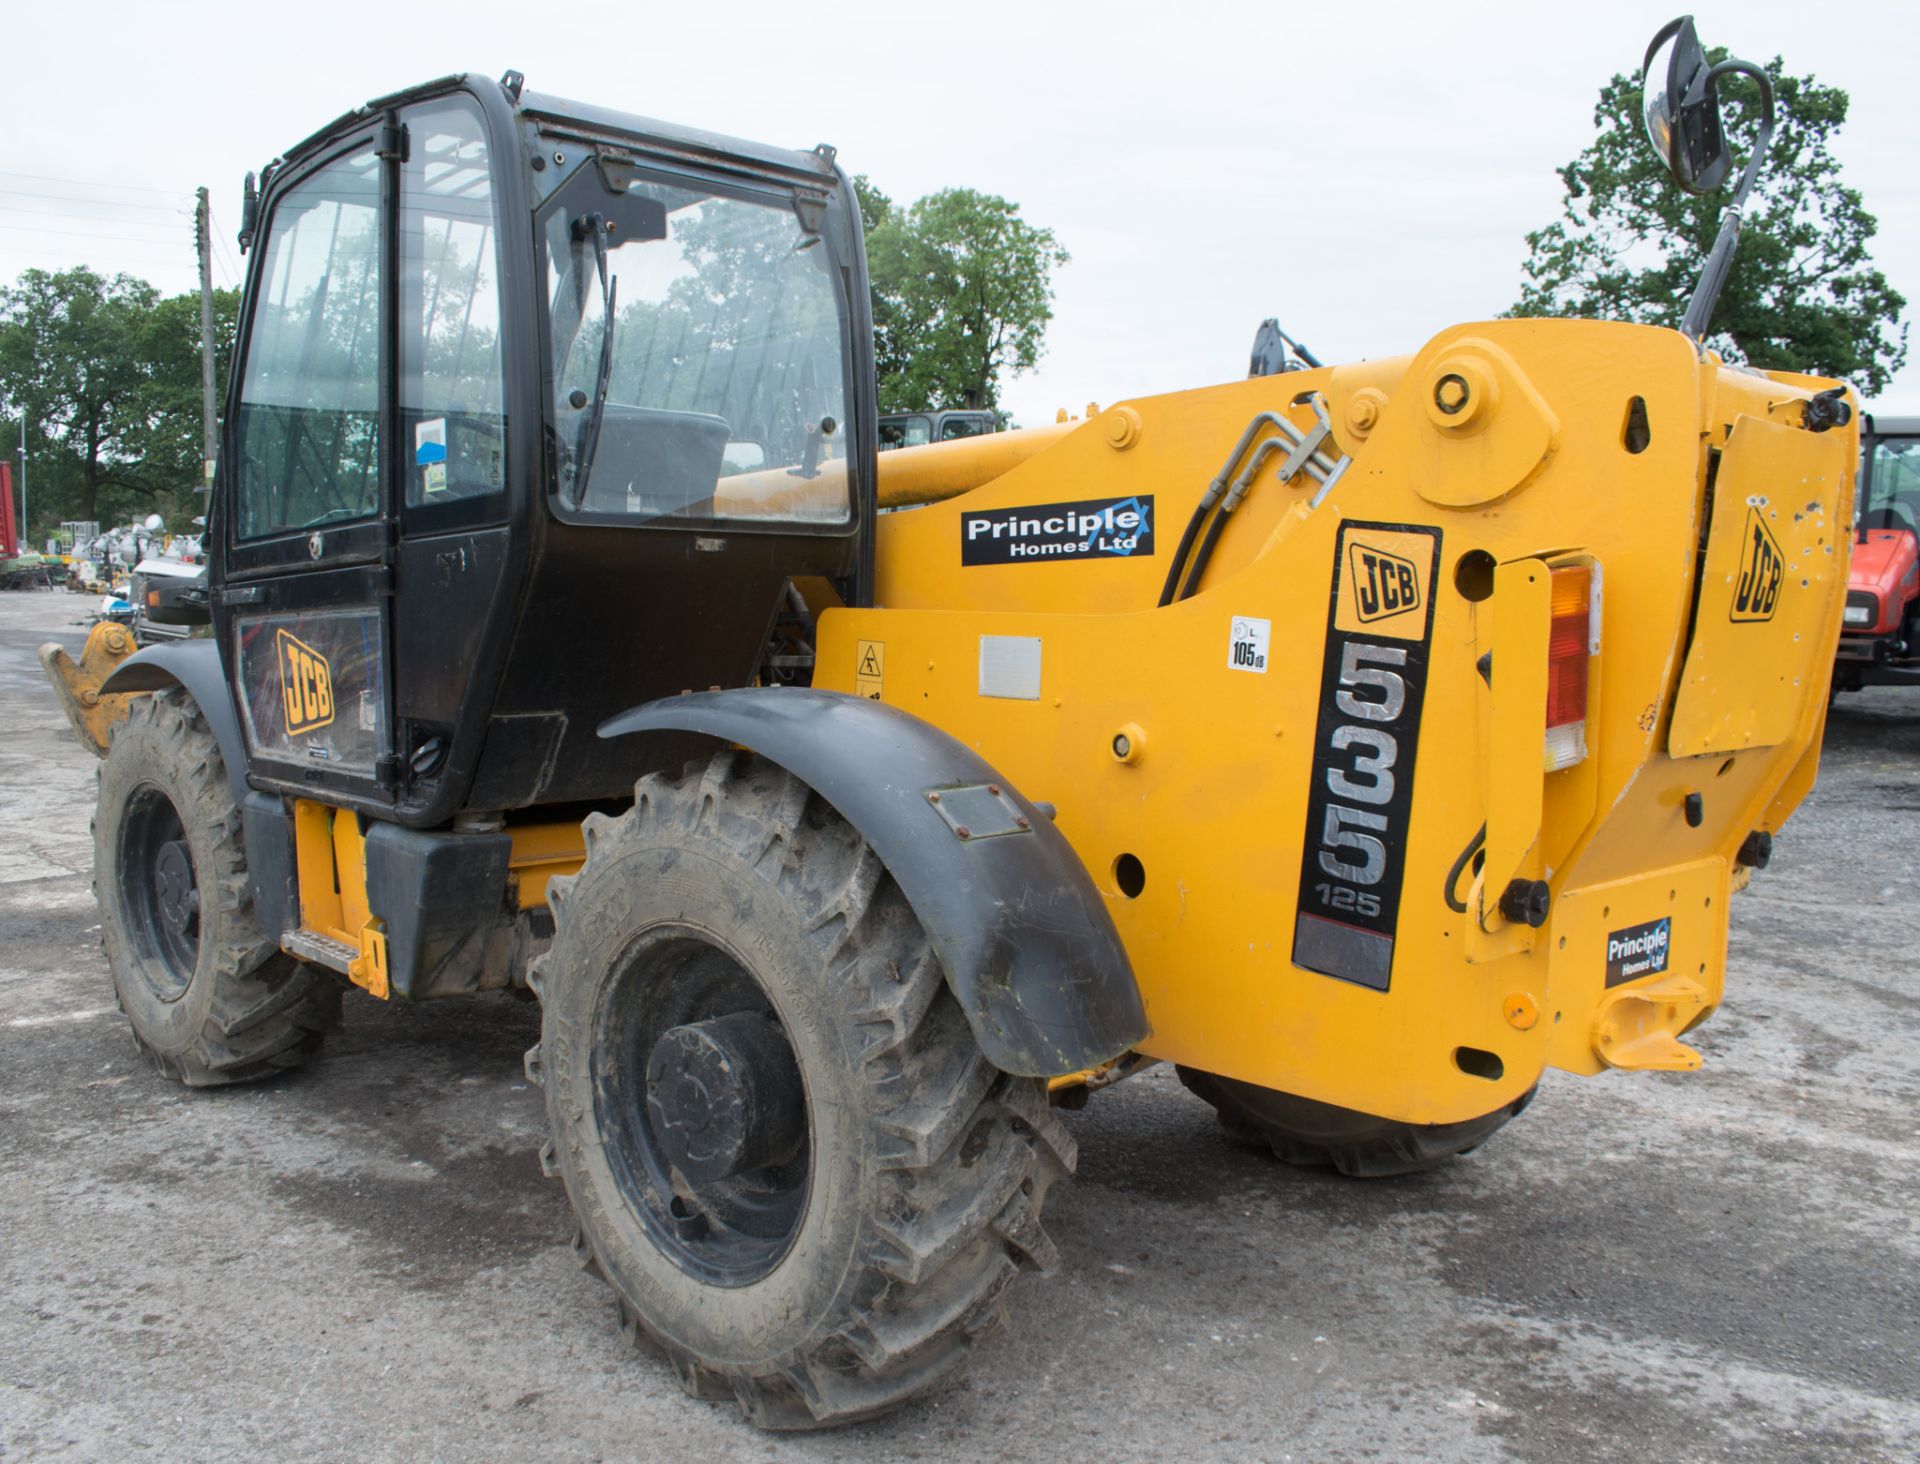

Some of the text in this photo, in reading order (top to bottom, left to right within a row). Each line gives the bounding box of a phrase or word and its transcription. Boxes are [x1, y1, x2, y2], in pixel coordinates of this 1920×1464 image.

[968, 507, 1140, 541] Principle
[1010, 535, 1138, 557] Homes Ltd
[1360, 553, 1416, 615] JCB
[1736, 523, 1781, 613] JCB
[286, 642, 331, 725] JCB
[1314, 883, 1381, 917] 125
[1608, 927, 1667, 962] Principle
[1622, 953, 1665, 977] Homes Ltd
